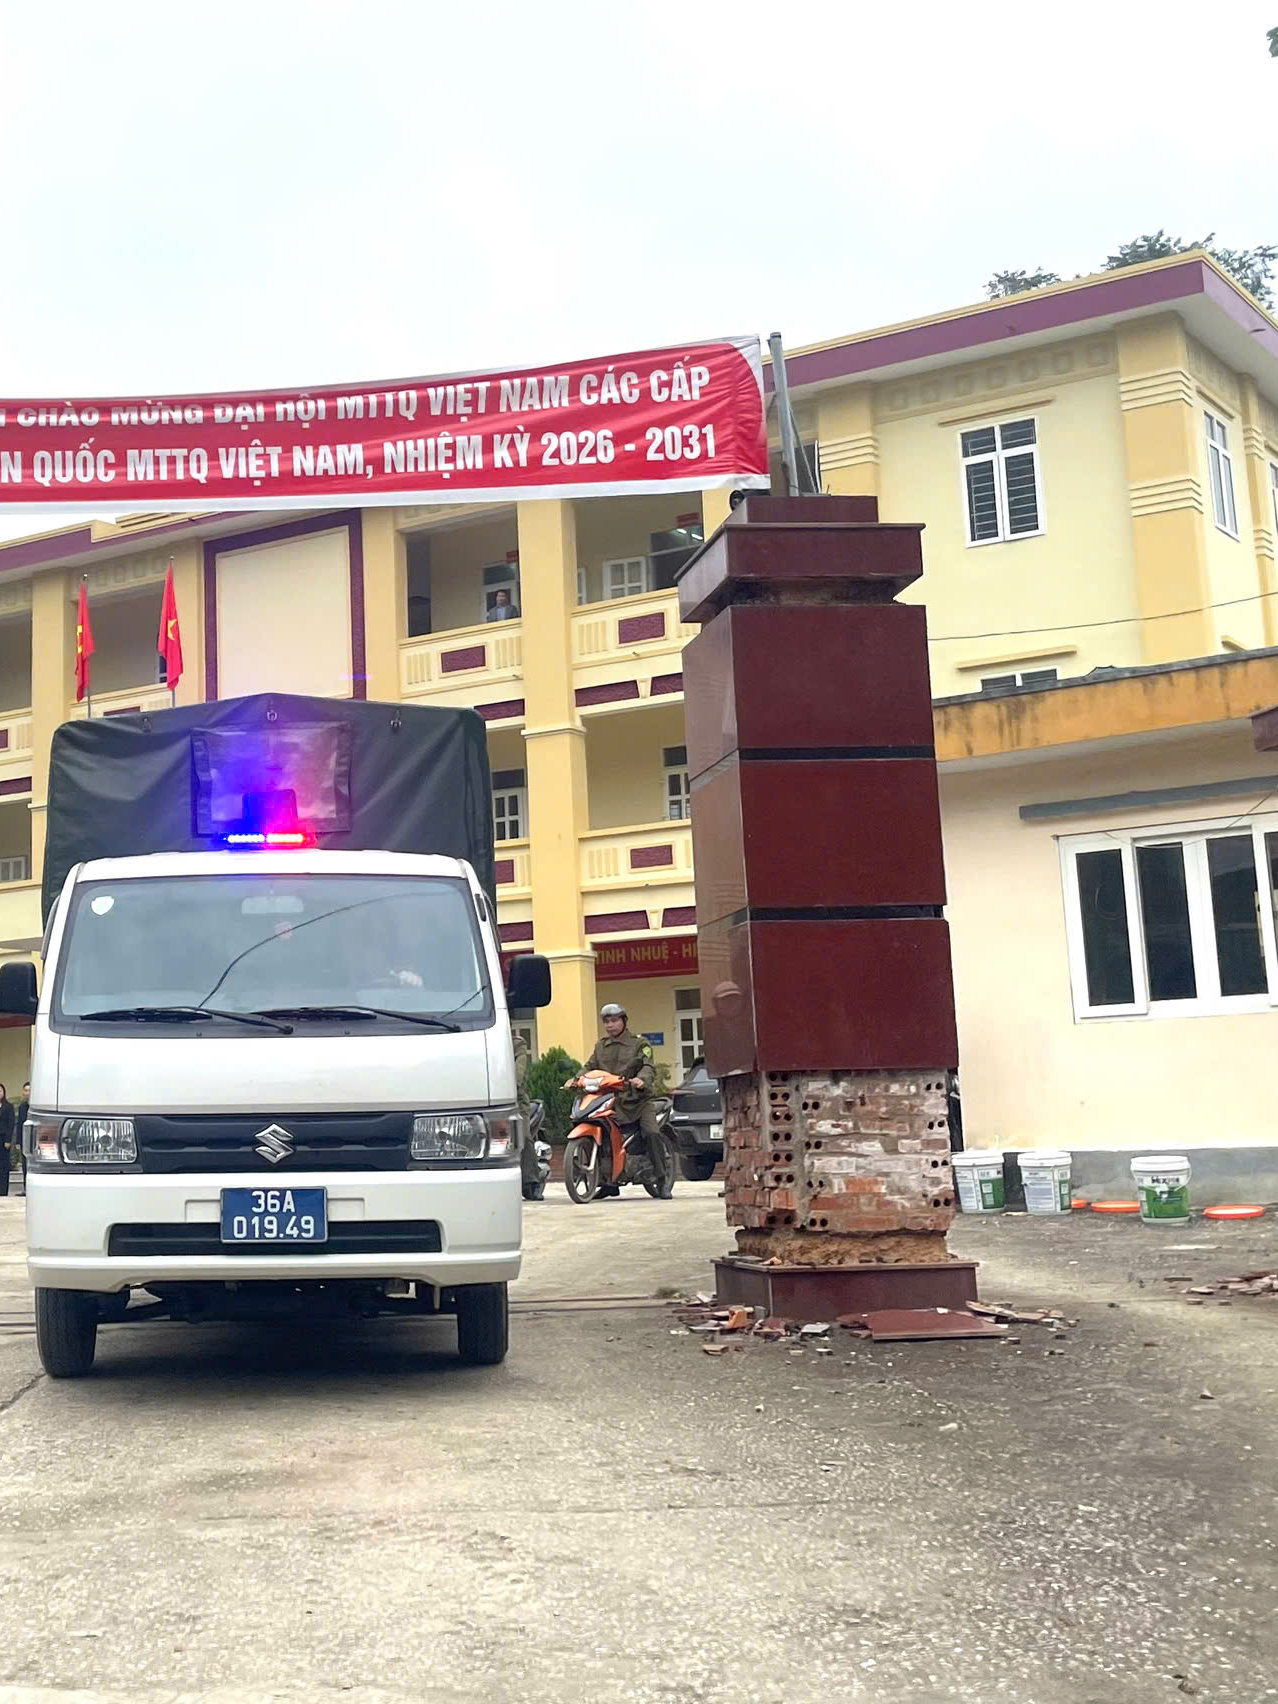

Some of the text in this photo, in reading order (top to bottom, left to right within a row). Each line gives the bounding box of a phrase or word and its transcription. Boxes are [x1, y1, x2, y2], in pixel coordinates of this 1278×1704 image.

[17, 401, 100, 427] CHÀO
[111, 400, 204, 426] MỪNG
[213, 401, 266, 431] ĐẠI
[275, 392, 326, 429] HỘI
[336, 389, 419, 421] MTTQ
[499, 375, 570, 413] NAM
[579, 365, 640, 406] CÁC
[649, 356, 711, 402] CẤP
[33, 437, 116, 487] QUỐC
[126, 448, 208, 484] MTTQ
[218, 439, 283, 486] VIỆT
[292, 443, 373, 479] NAM,
[383, 431, 484, 479] NHIỆM
[493, 425, 531, 468] KỲ
[540, 429, 616, 466] 2026
[624, 442, 636, 451] -
[645, 424, 716, 461] 2031
[251, 1190, 295, 1213] 36A
[233, 1215, 315, 1238] 019.49
